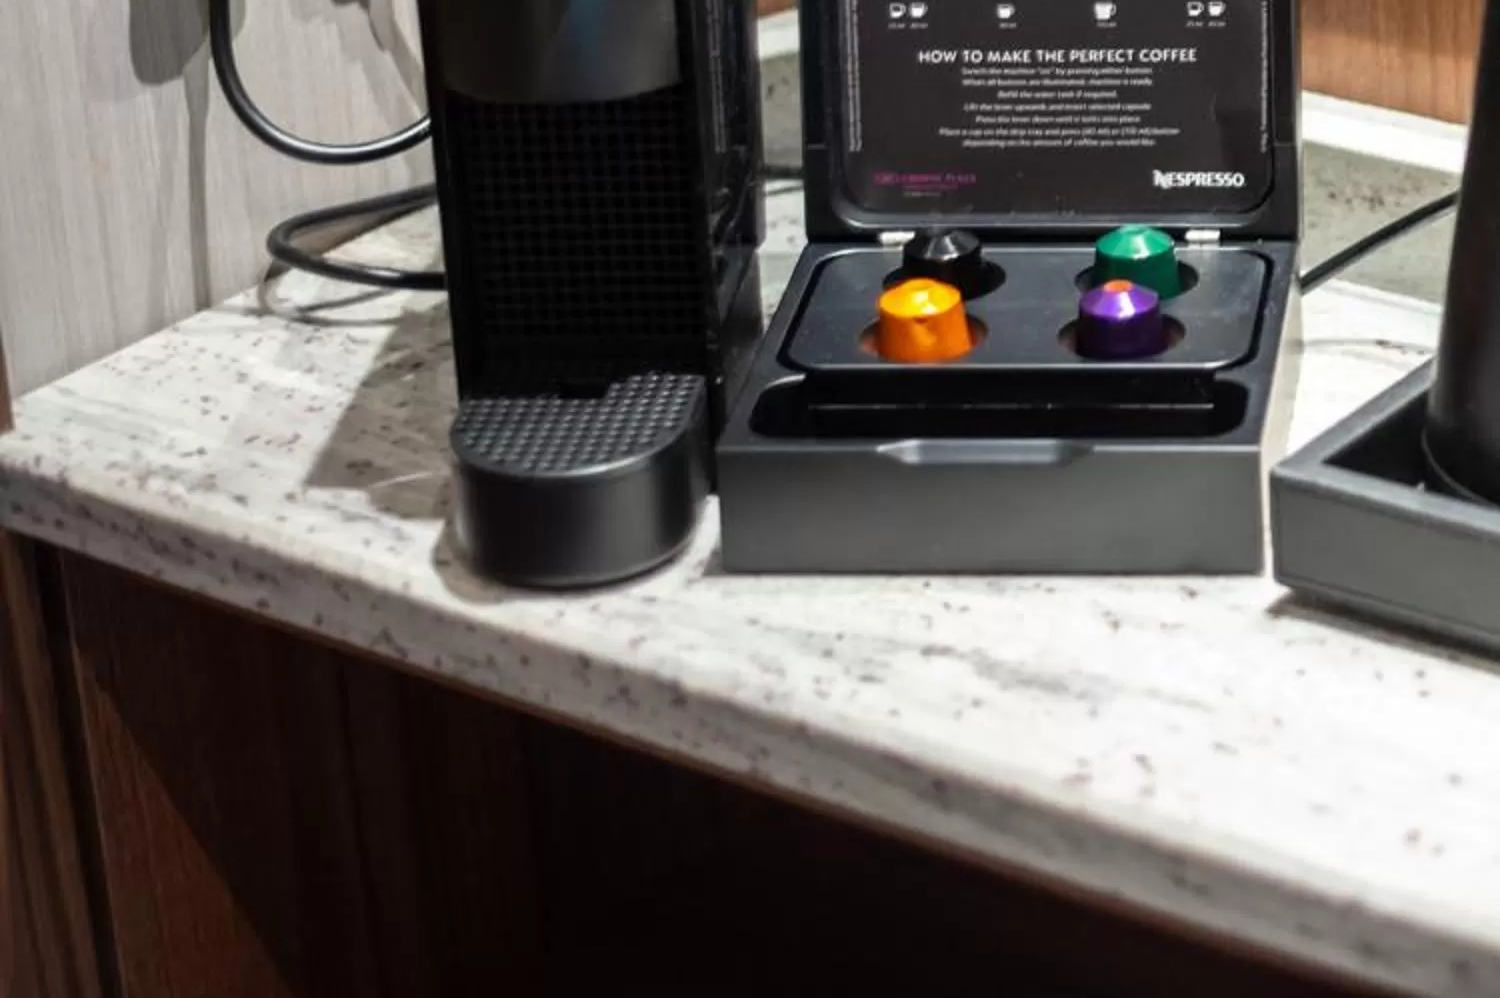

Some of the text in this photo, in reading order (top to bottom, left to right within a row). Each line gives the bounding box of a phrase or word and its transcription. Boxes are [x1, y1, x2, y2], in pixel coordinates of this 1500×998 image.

[919, 49, 1197, 63] HOW TO MAKE THE PERFECT COFFEE
[1152, 169, 1245, 190] NESPRESSO
